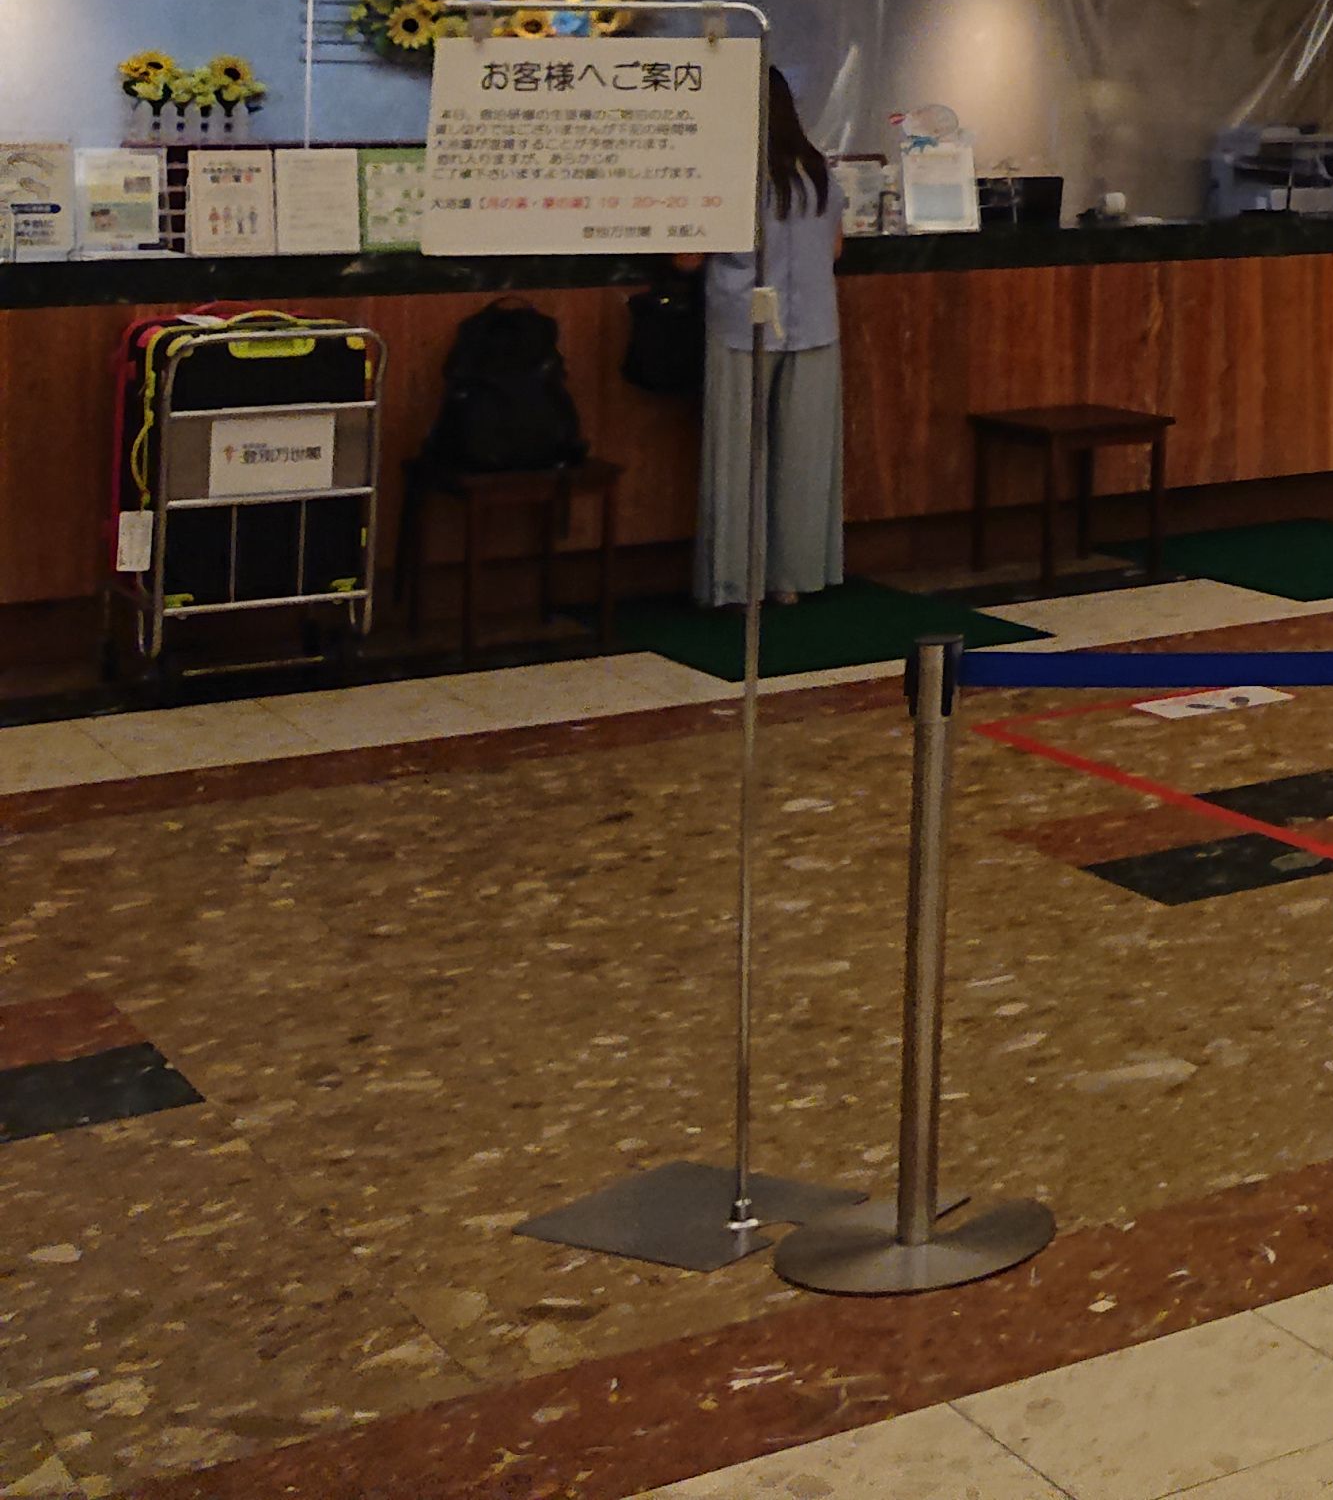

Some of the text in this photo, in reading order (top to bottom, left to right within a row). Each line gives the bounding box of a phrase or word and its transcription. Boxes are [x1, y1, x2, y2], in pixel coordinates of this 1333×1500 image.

[481, 60, 704, 93] お客様へご案内
